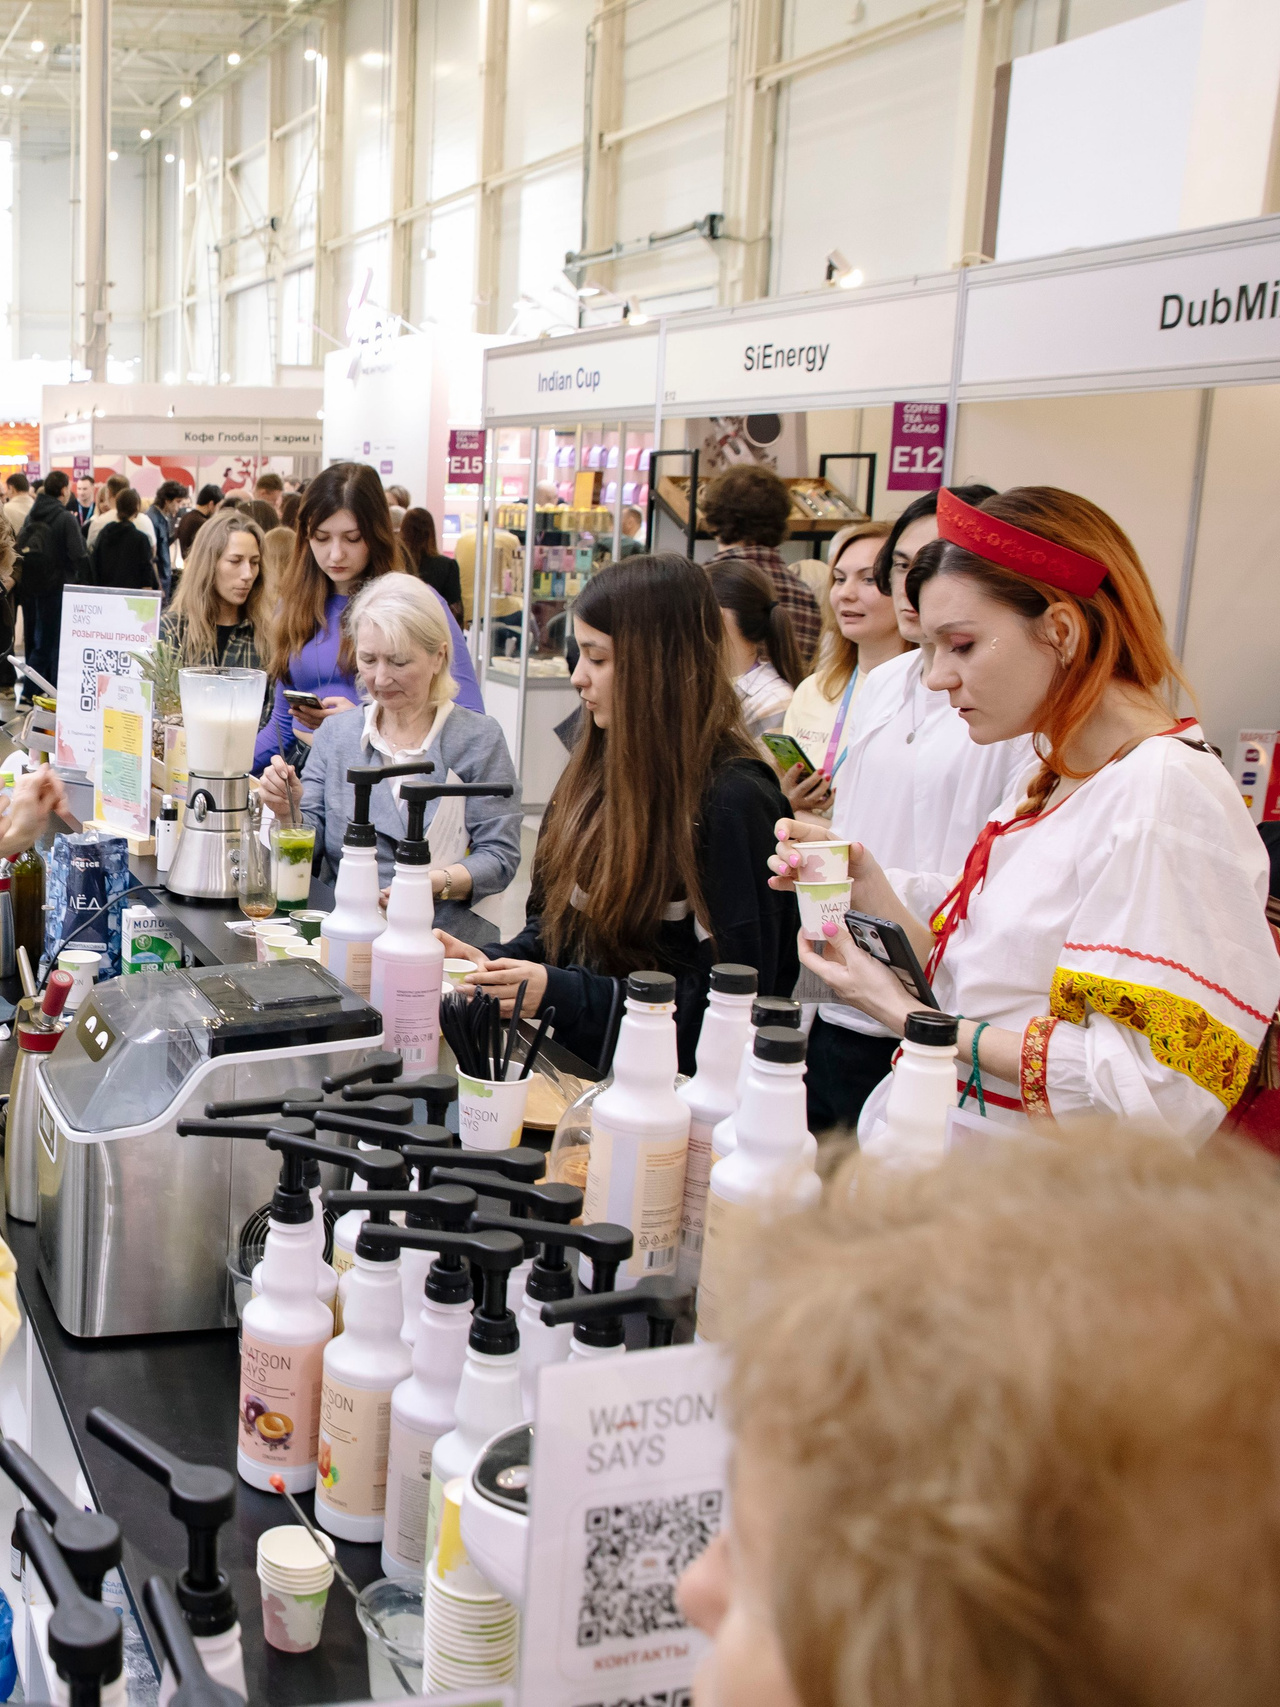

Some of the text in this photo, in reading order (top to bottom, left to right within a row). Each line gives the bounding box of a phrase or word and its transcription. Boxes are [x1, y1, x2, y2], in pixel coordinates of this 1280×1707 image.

[1159, 280, 1280, 330] DubMi
[744, 343, 830, 372] SiEnergy
[537, 366, 601, 393] Indian Cup
[903, 403, 941, 414] COFFEE
[903, 413, 923, 424] TEA
[902, 423, 940, 434] CACAO
[184, 432, 214, 443] Кофе
[218, 432, 259, 442] Глобал
[273, 434, 310, 444] жарим
[450, 455, 483, 474] E15
[892, 445, 944, 474] E12
[73, 604, 103, 615] WATSON
[72, 614, 91, 624] SAYS
[72, 629, 148, 643] РОЗЫГРЫШ ПРИЗОВ!
[70, 893, 102, 911] ЛЁД
[820, 901, 849, 914] WATS
[133, 919, 165, 929] МОЛО
[323, 1383, 354, 1413] TSON
[588, 1393, 719, 1438] WATSON
[586, 1434, 666, 1475] SAYS
[592, 1642, 691, 1672] КОНТАКТЫ
